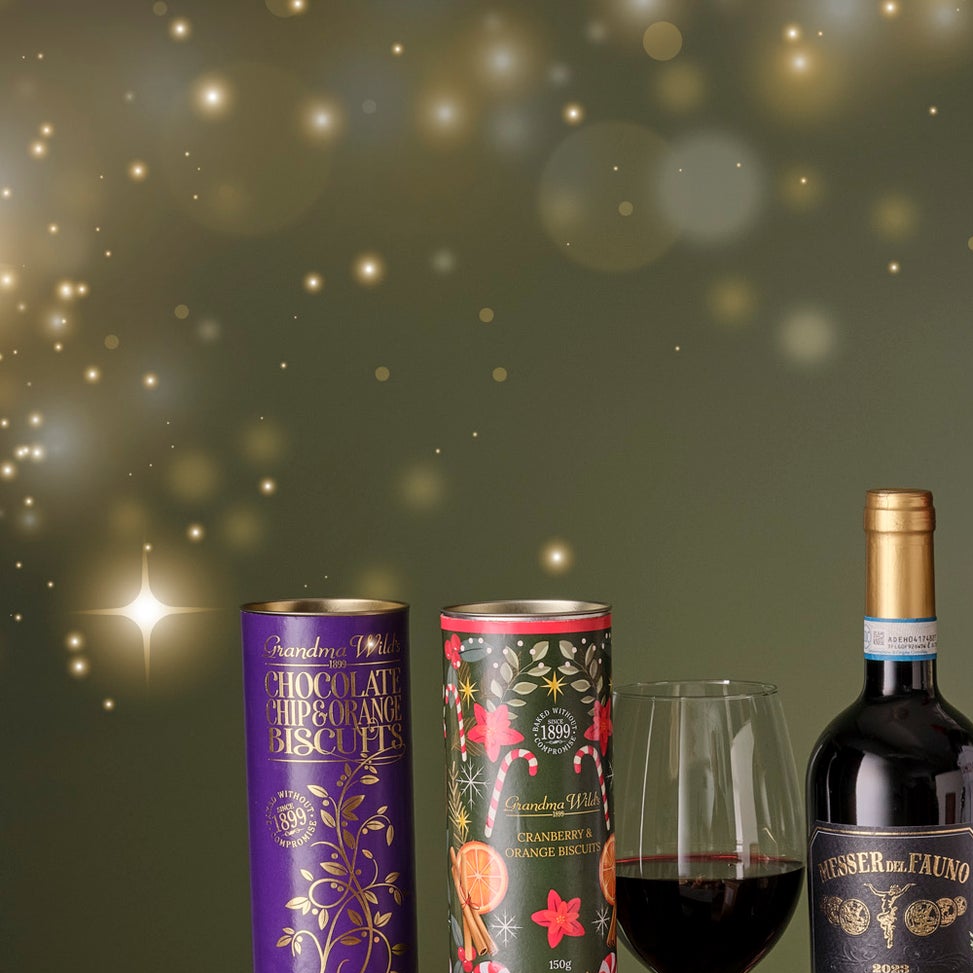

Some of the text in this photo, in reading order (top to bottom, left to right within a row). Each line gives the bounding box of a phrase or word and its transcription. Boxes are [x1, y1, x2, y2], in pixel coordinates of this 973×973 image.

[262, 635, 347, 659] Grandma
[329, 660, 347, 668] 1899
[265, 667, 401, 699] CHOCOLATE
[532, 707, 577, 732] BAKED WITHOUT
[269, 723, 405, 756] BISCUITS
[540, 723, 571, 740] 1899
[534, 736, 576, 755] COMPROMISE
[277, 790, 315, 813] WITHOUT
[503, 795, 565, 812] Grandma
[272, 807, 307, 832] 1899
[271, 820, 317, 848] COMPROMISE
[517, 827, 593, 843] CRANBERRY &
[505, 841, 601, 858] ORANGE BISCUITS
[818, 851, 970, 884] MESSER DEL FAUNO
[549, 959, 572, 972] 150g
[872, 963, 910, 973] 2023
